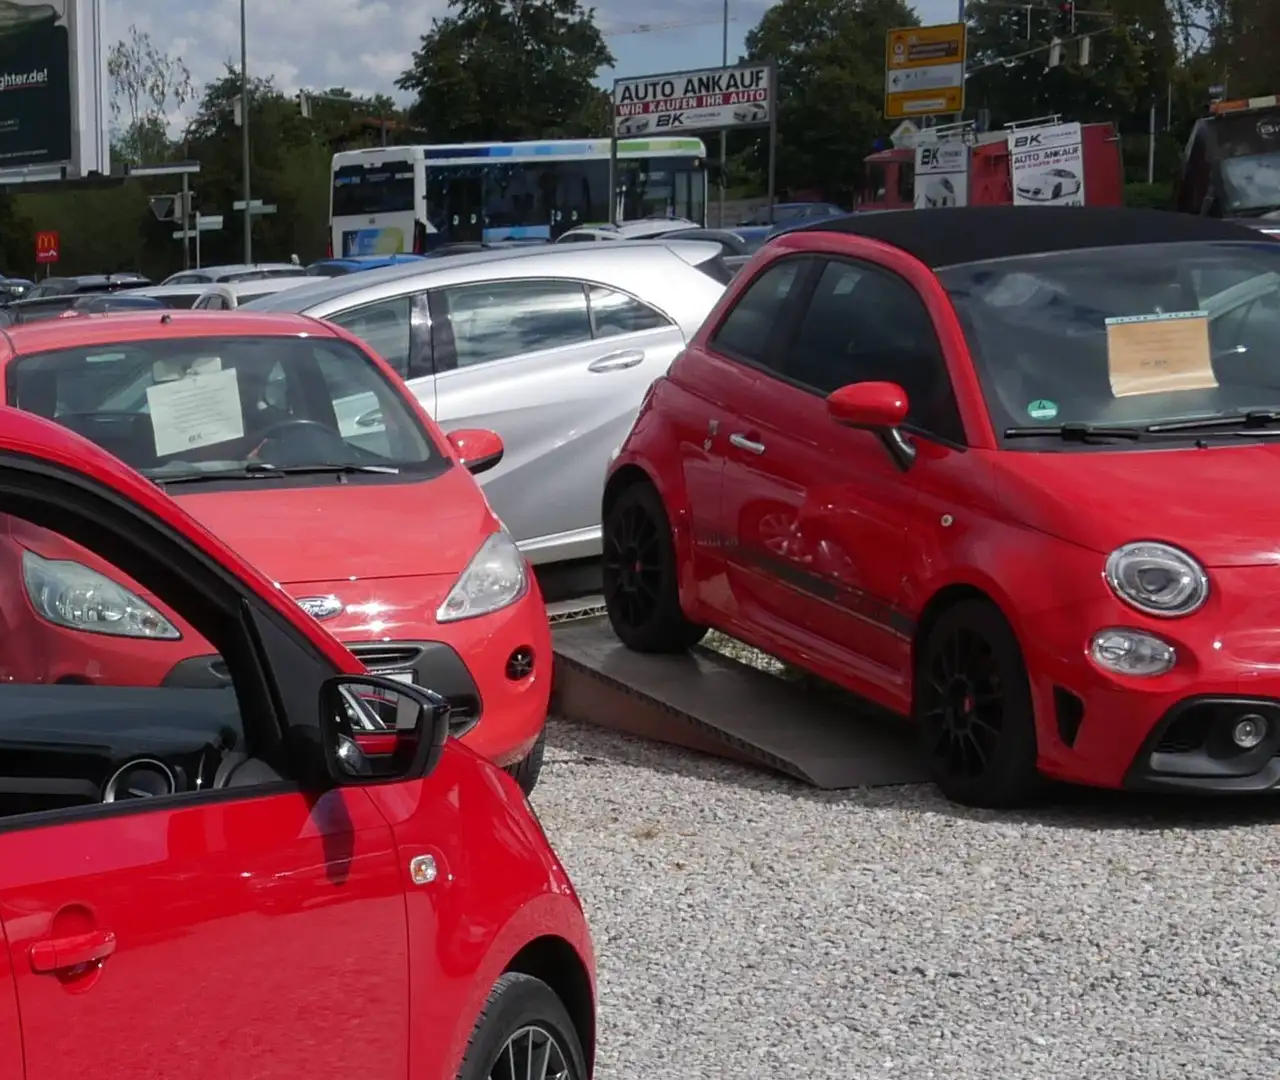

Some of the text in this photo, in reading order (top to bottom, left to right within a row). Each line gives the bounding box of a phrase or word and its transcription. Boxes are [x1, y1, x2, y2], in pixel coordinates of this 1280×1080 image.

[620, 69, 765, 103] AUTO ANKAUF
[619, 89, 765, 116] WIR KAUFEN IHR AUTO
[655, 112, 684, 128] BK
[1014, 133, 1042, 148] BK
[920, 147, 940, 165] BK
[1014, 146, 1080, 164] AUTO ANKAUF
